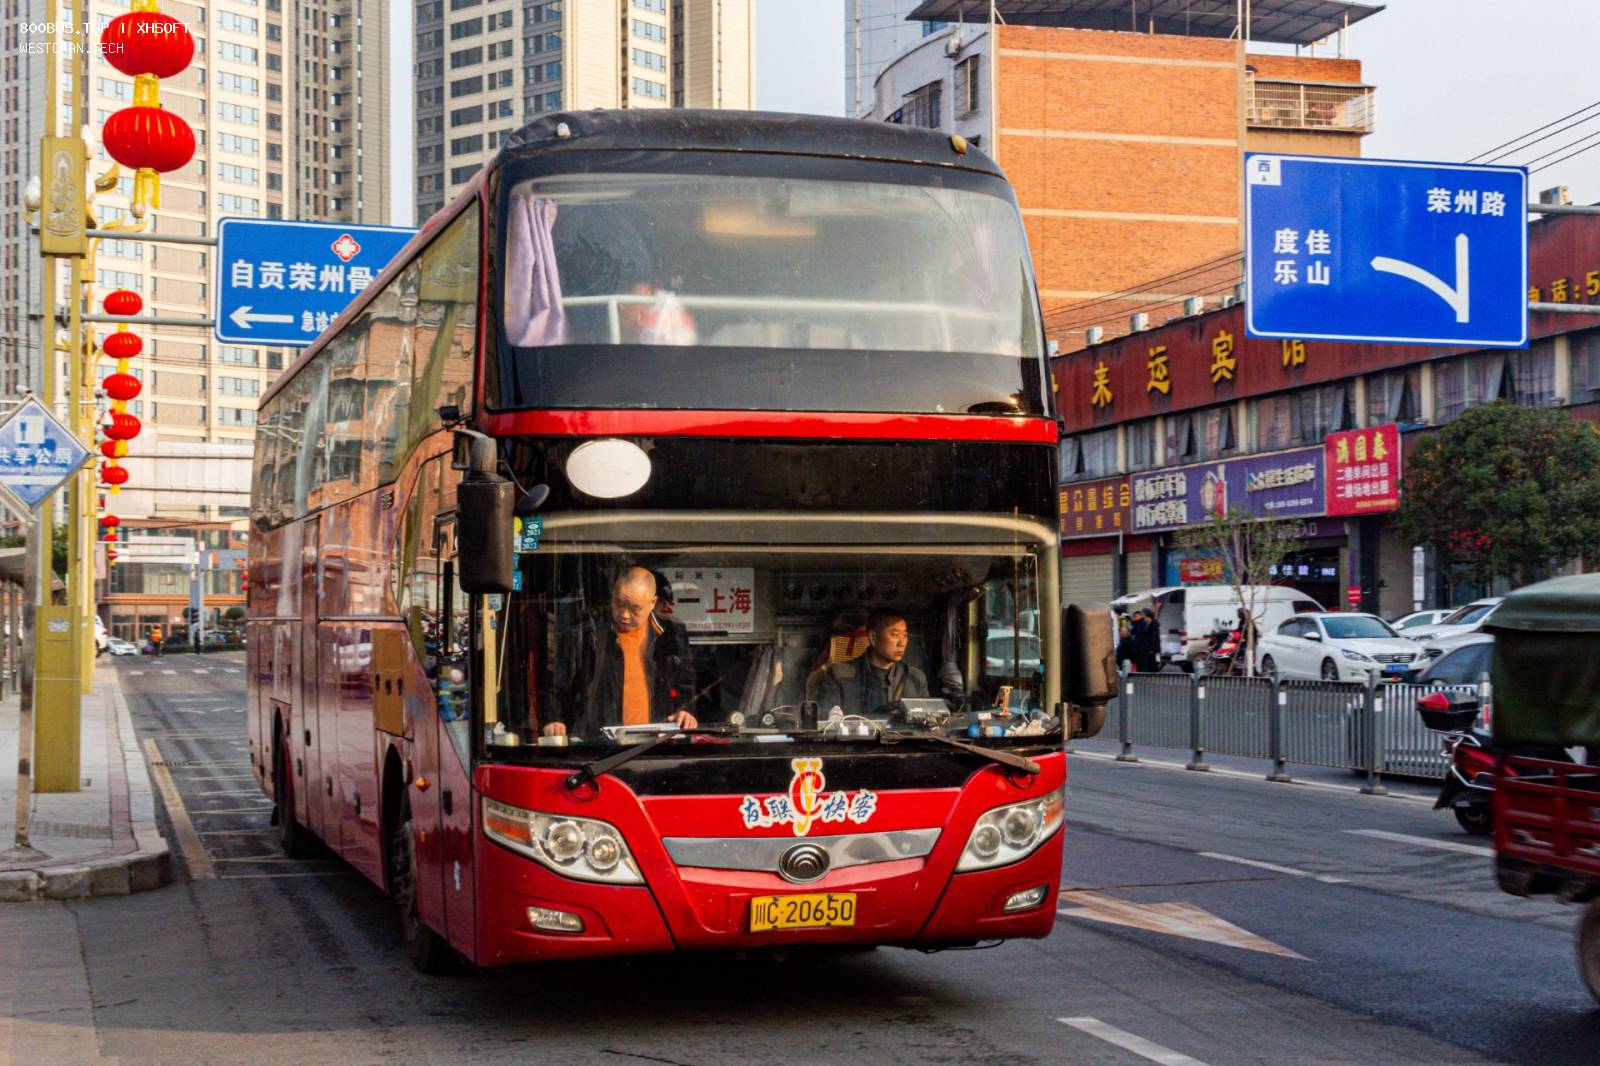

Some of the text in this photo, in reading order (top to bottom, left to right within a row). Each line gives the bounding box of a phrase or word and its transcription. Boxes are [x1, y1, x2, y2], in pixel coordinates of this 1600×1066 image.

[1258, 160, 1272, 172] 西
[1426, 187, 1506, 217] 荣州路
[1273, 228, 1331, 255] 度佳
[231, 259, 386, 294] 自贡荣州骨
[1273, 260, 1331, 286] 乐山
[1051, 330, 1306, 408] 来运宾
[704, 586, 752, 614] 上海
